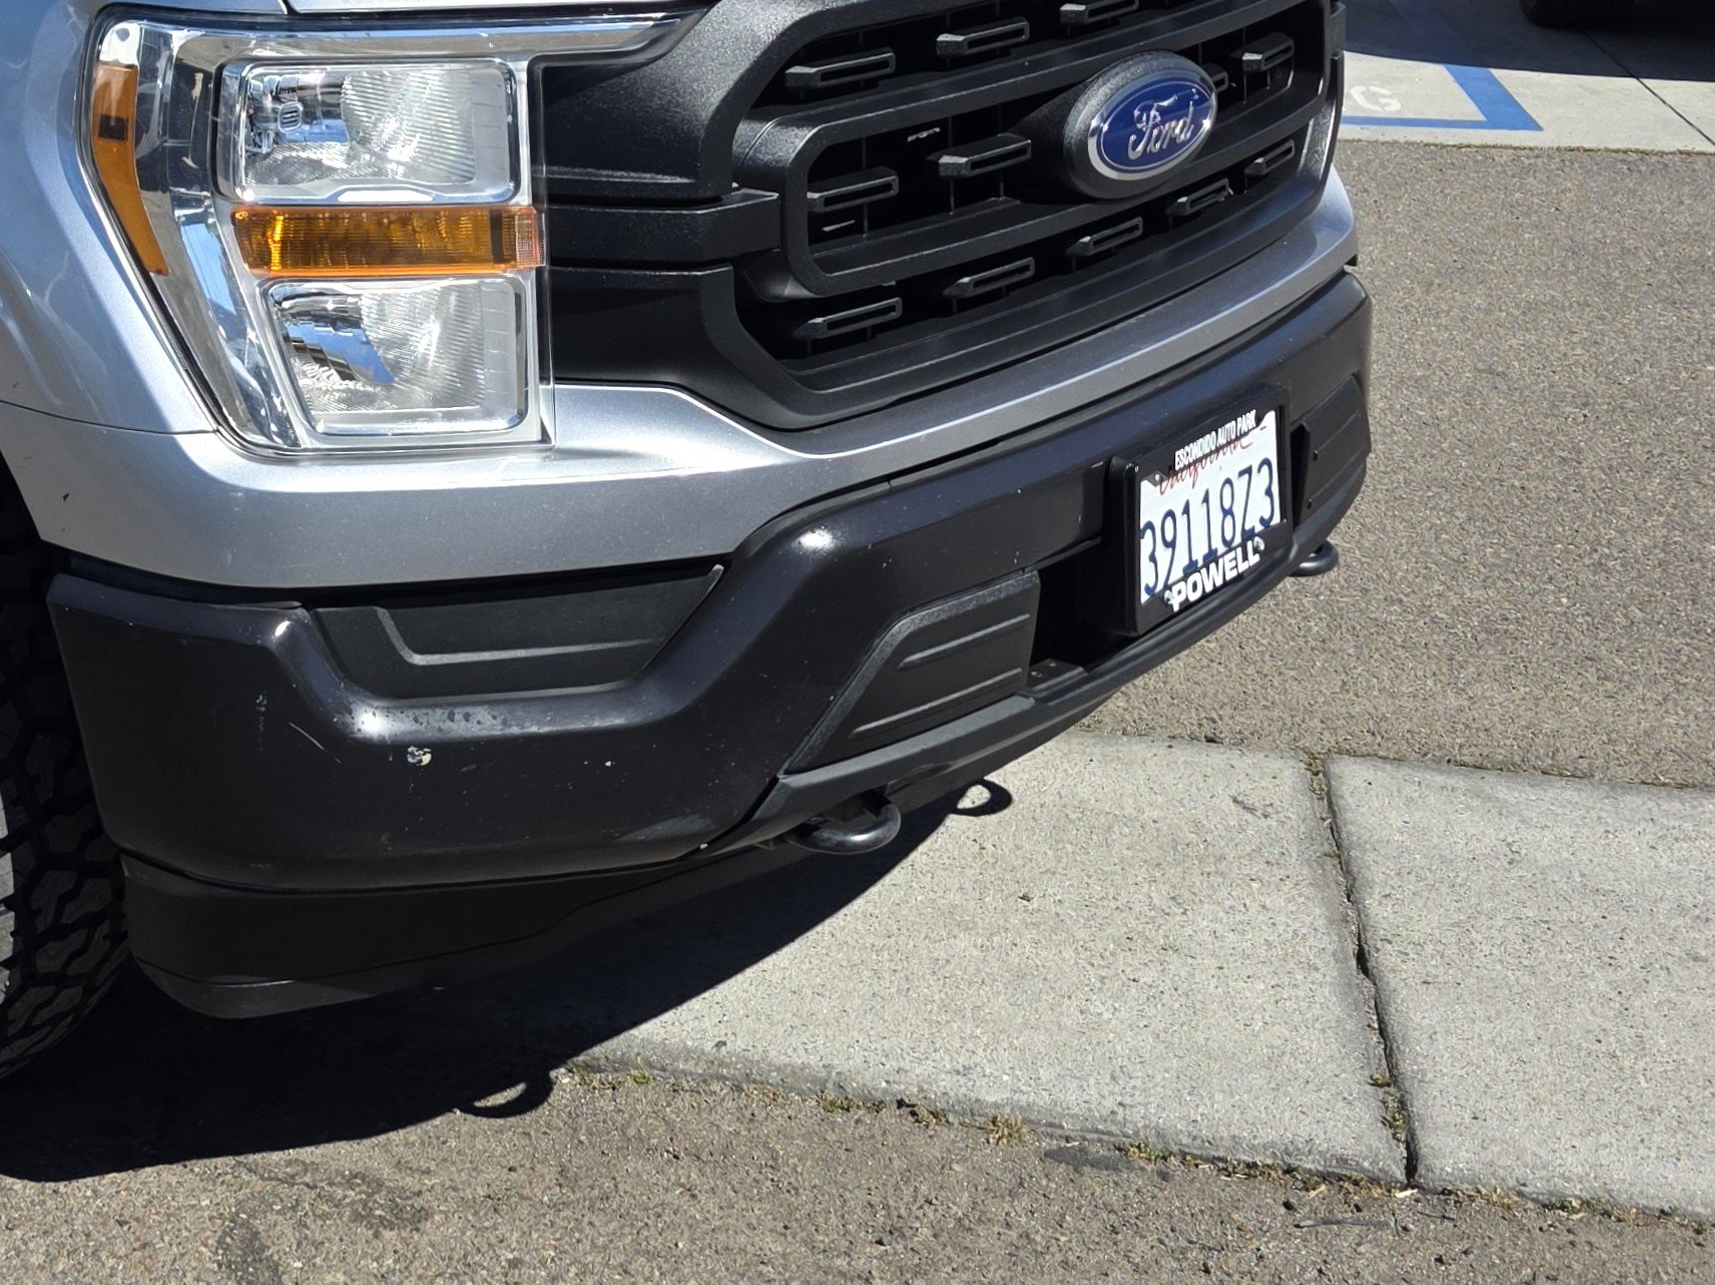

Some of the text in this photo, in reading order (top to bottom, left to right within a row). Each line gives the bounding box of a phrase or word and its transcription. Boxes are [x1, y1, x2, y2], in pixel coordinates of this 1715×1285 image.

[1127, 94, 1196, 161] Ford
[1174, 409, 1257, 472] ESCONDIDO AUTO PARK
[1168, 539, 1261, 612] POWELL
